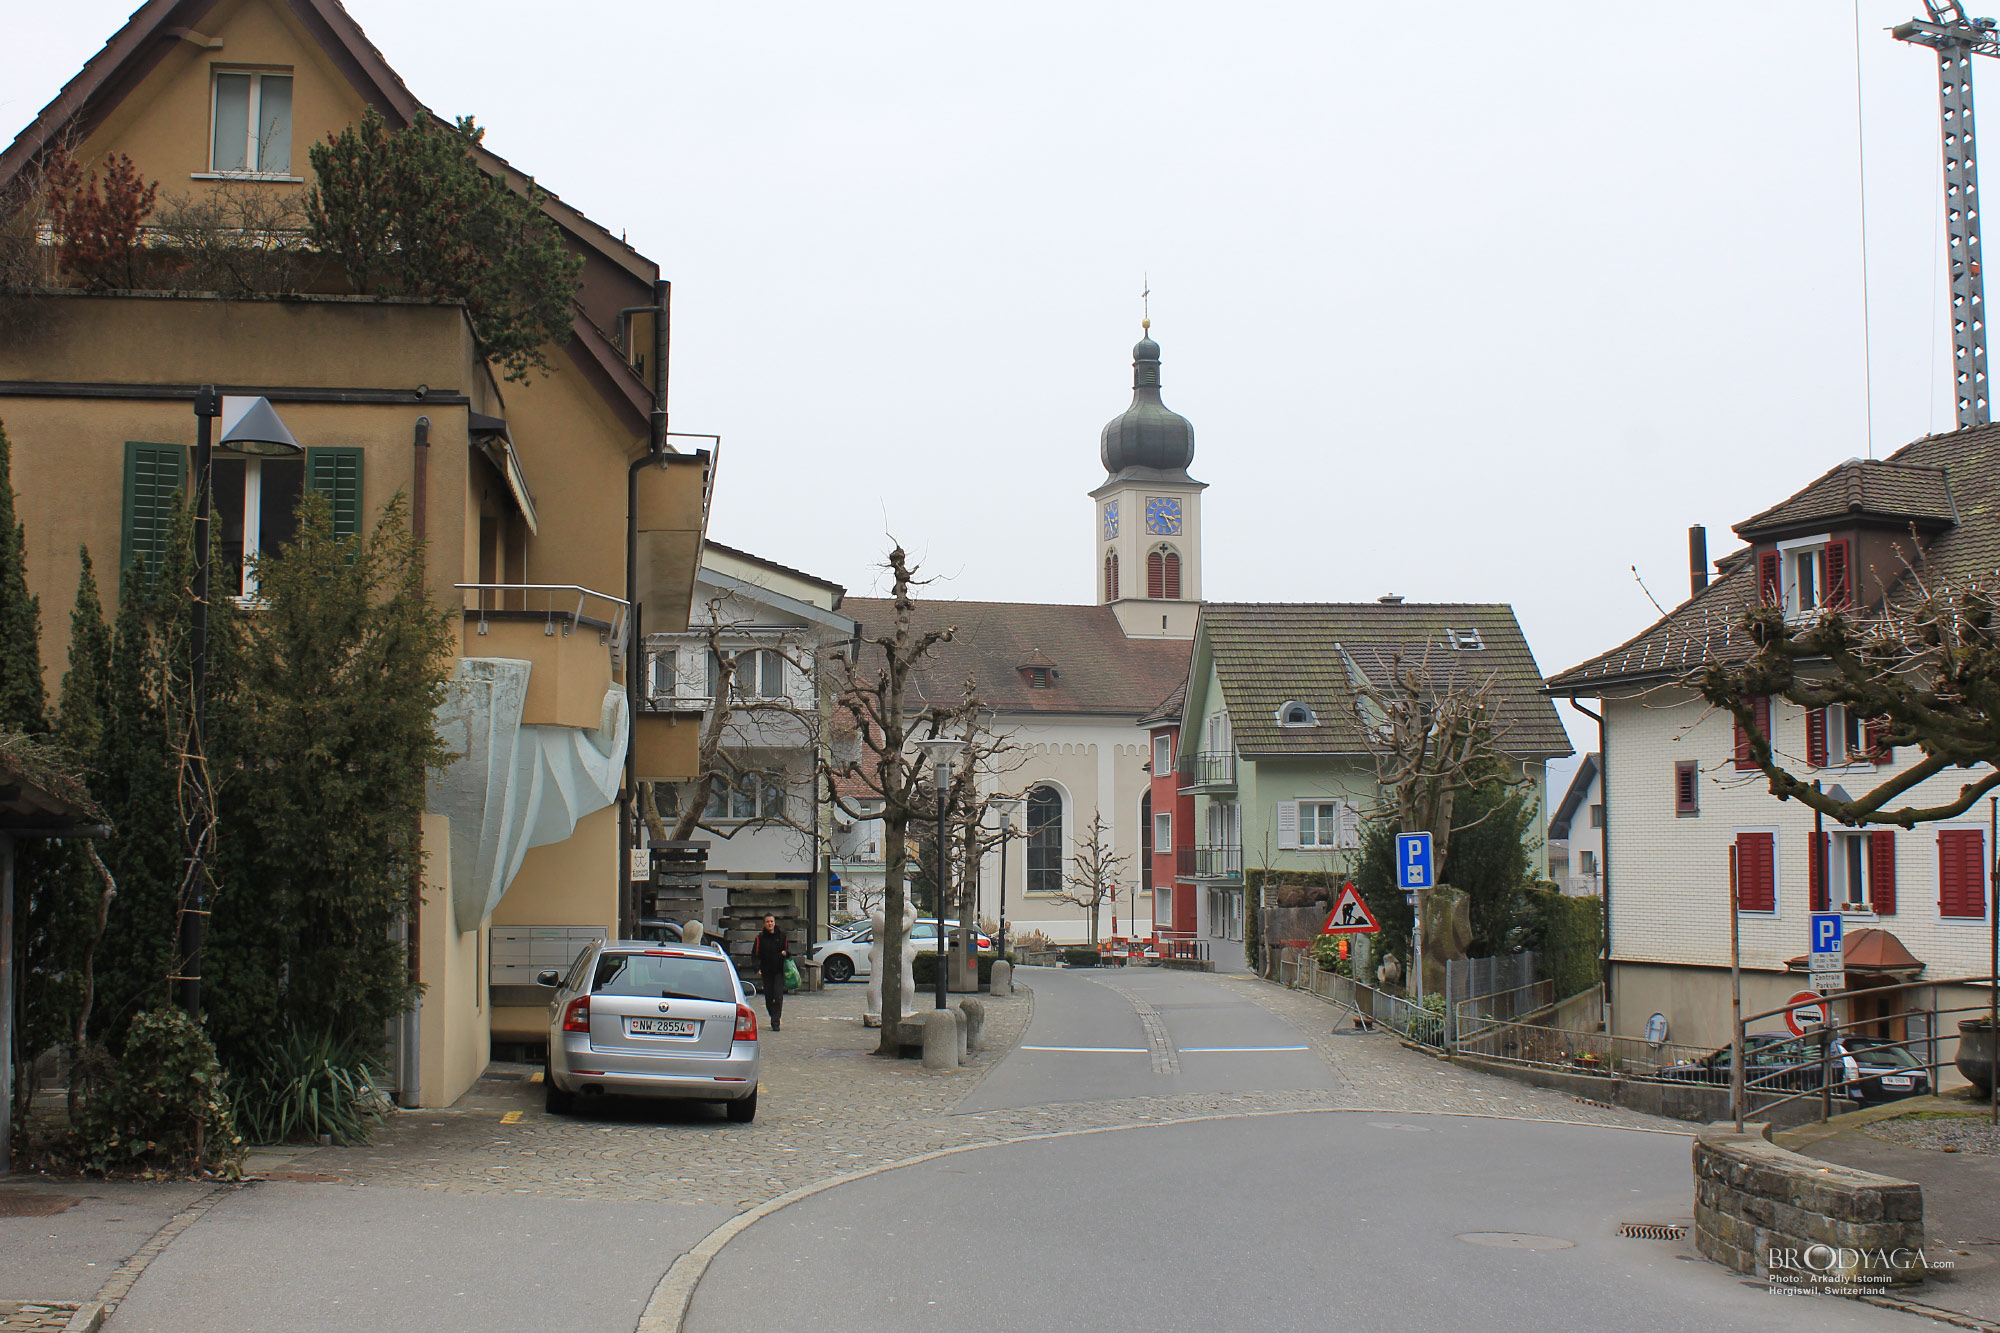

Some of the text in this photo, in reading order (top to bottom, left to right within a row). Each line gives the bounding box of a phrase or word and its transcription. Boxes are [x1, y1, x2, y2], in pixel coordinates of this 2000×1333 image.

[1408, 840, 1422, 864] P
[1819, 920, 1834, 948] P
[1815, 973, 1840, 981] Zentrale
[1816, 981, 1840, 989] Parkuhr
[639, 1020, 686, 1032] NW 28554
